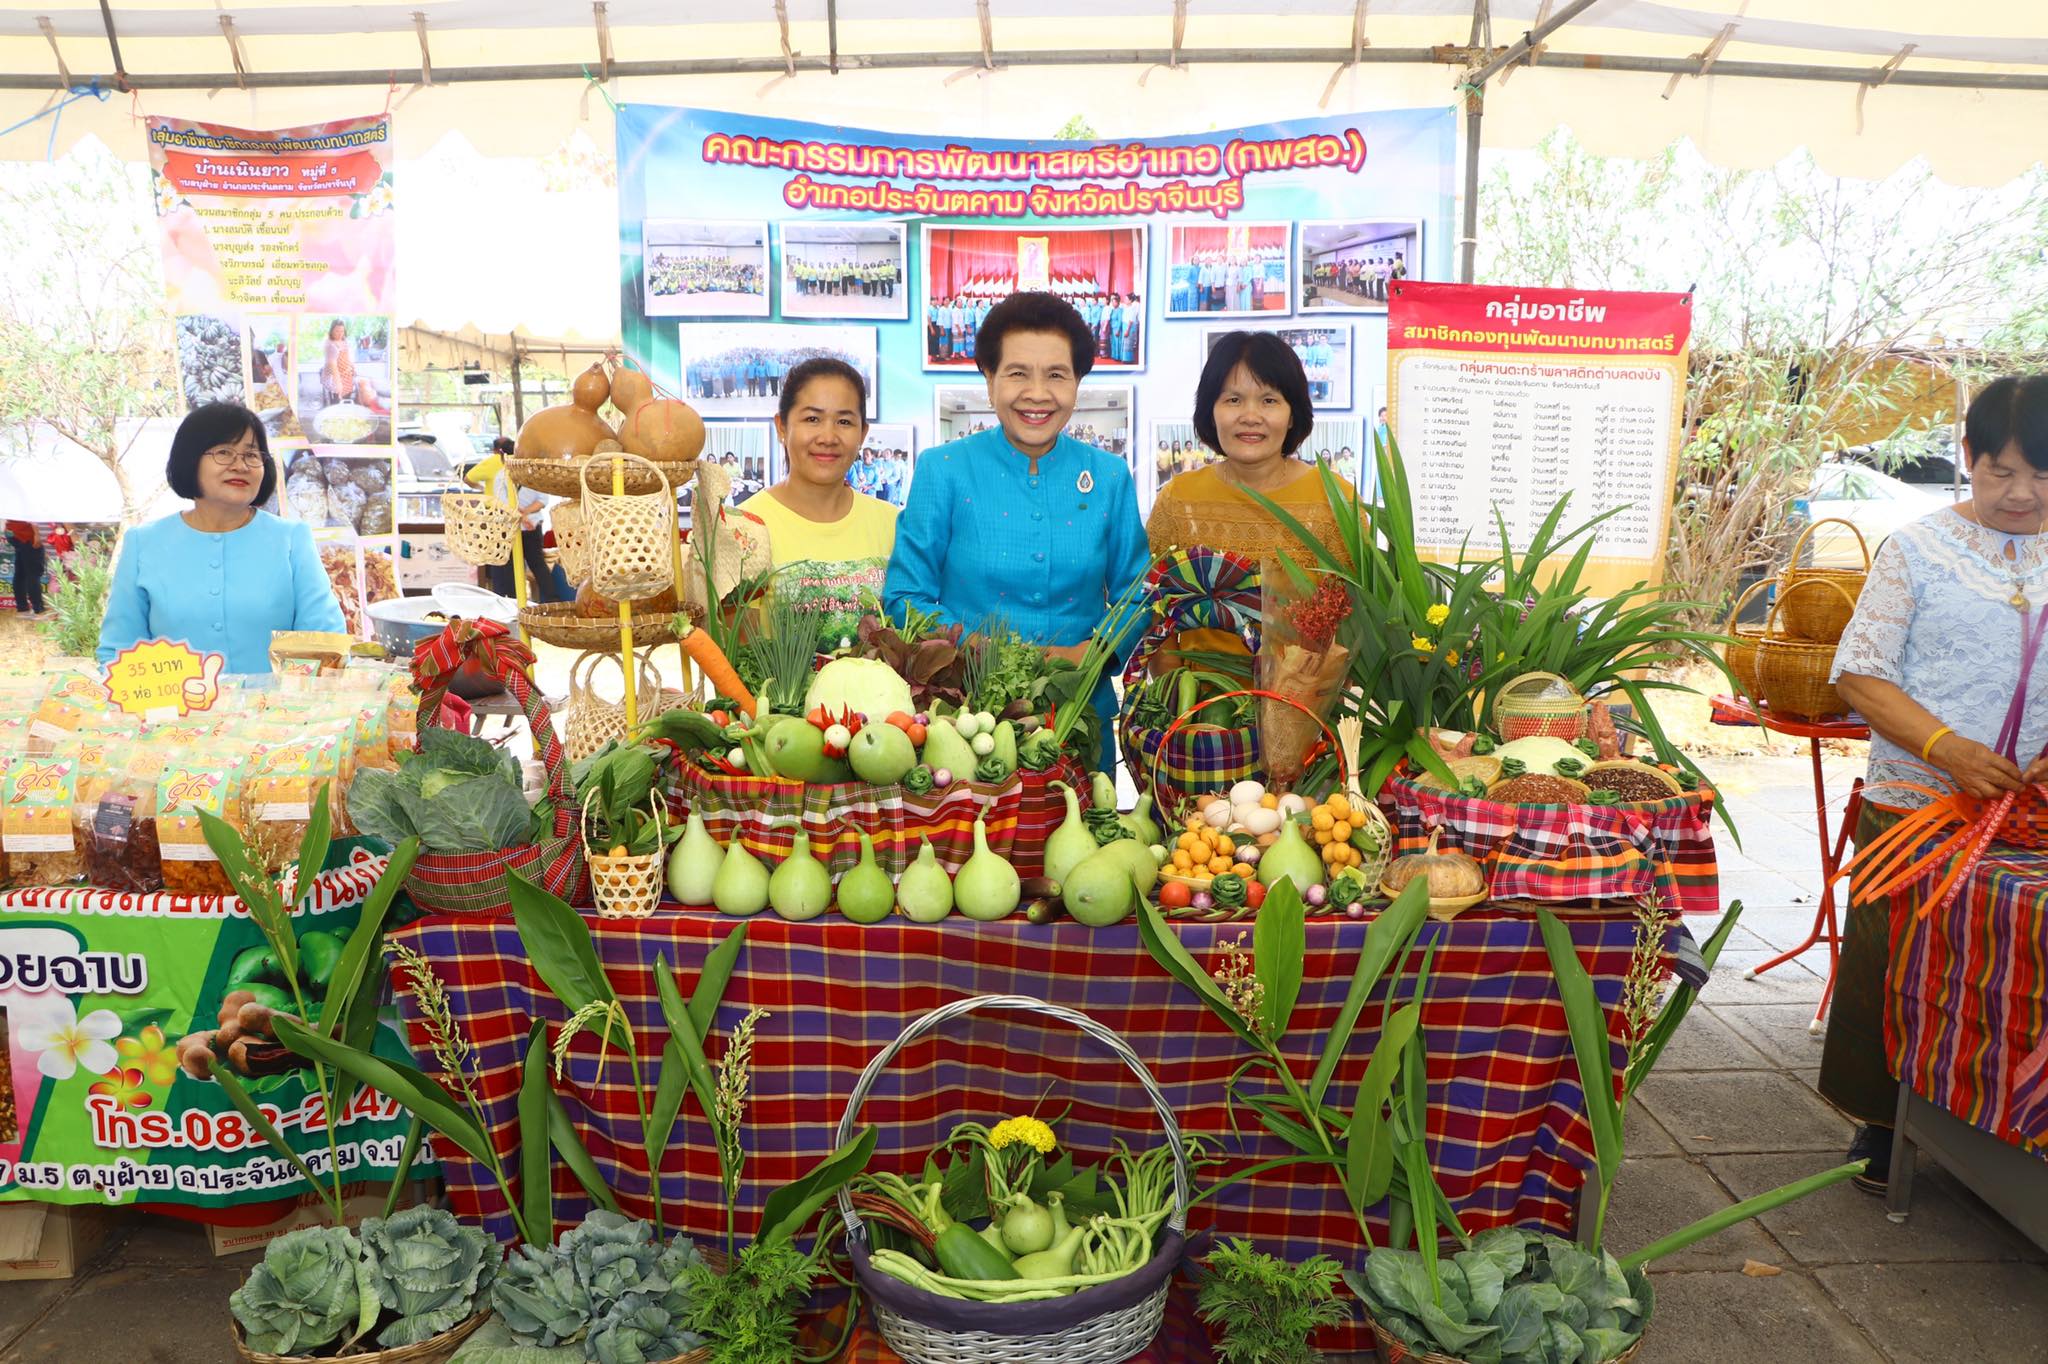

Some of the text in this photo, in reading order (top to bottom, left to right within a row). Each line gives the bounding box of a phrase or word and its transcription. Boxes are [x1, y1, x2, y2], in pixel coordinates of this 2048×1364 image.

[152, 125, 385, 153] ลุ่มอาชีพสมาชิกกองทุนพัฒนาบทบาทสตรี
[195, 158, 289, 176] บ้านเนินยาว
[704, 129, 1366, 179] คณะกรรมการพัฒนาสตรีอำเภอ (กพสอ.)
[784, 174, 1244, 218] อำเภอประจันตคาม จังหวัดปราจีนบุรี
[1486, 295, 1606, 326] กลุ่มอาชีพ
[1404, 325, 1674, 351] สมาชิกกองทุนพัฒนาบทบาทสตรี
[1460, 360, 1661, 381] กลุ่มสานตะกร้าพลาสติกตำบลดงบัง
[127, 659, 183, 678] 35 บาท
[121, 683, 180, 702] 3 ห่อ 100
[18, 1167, 59, 1185] ม.5
[73, 1161, 169, 1197] ต.บุฝ้าย
